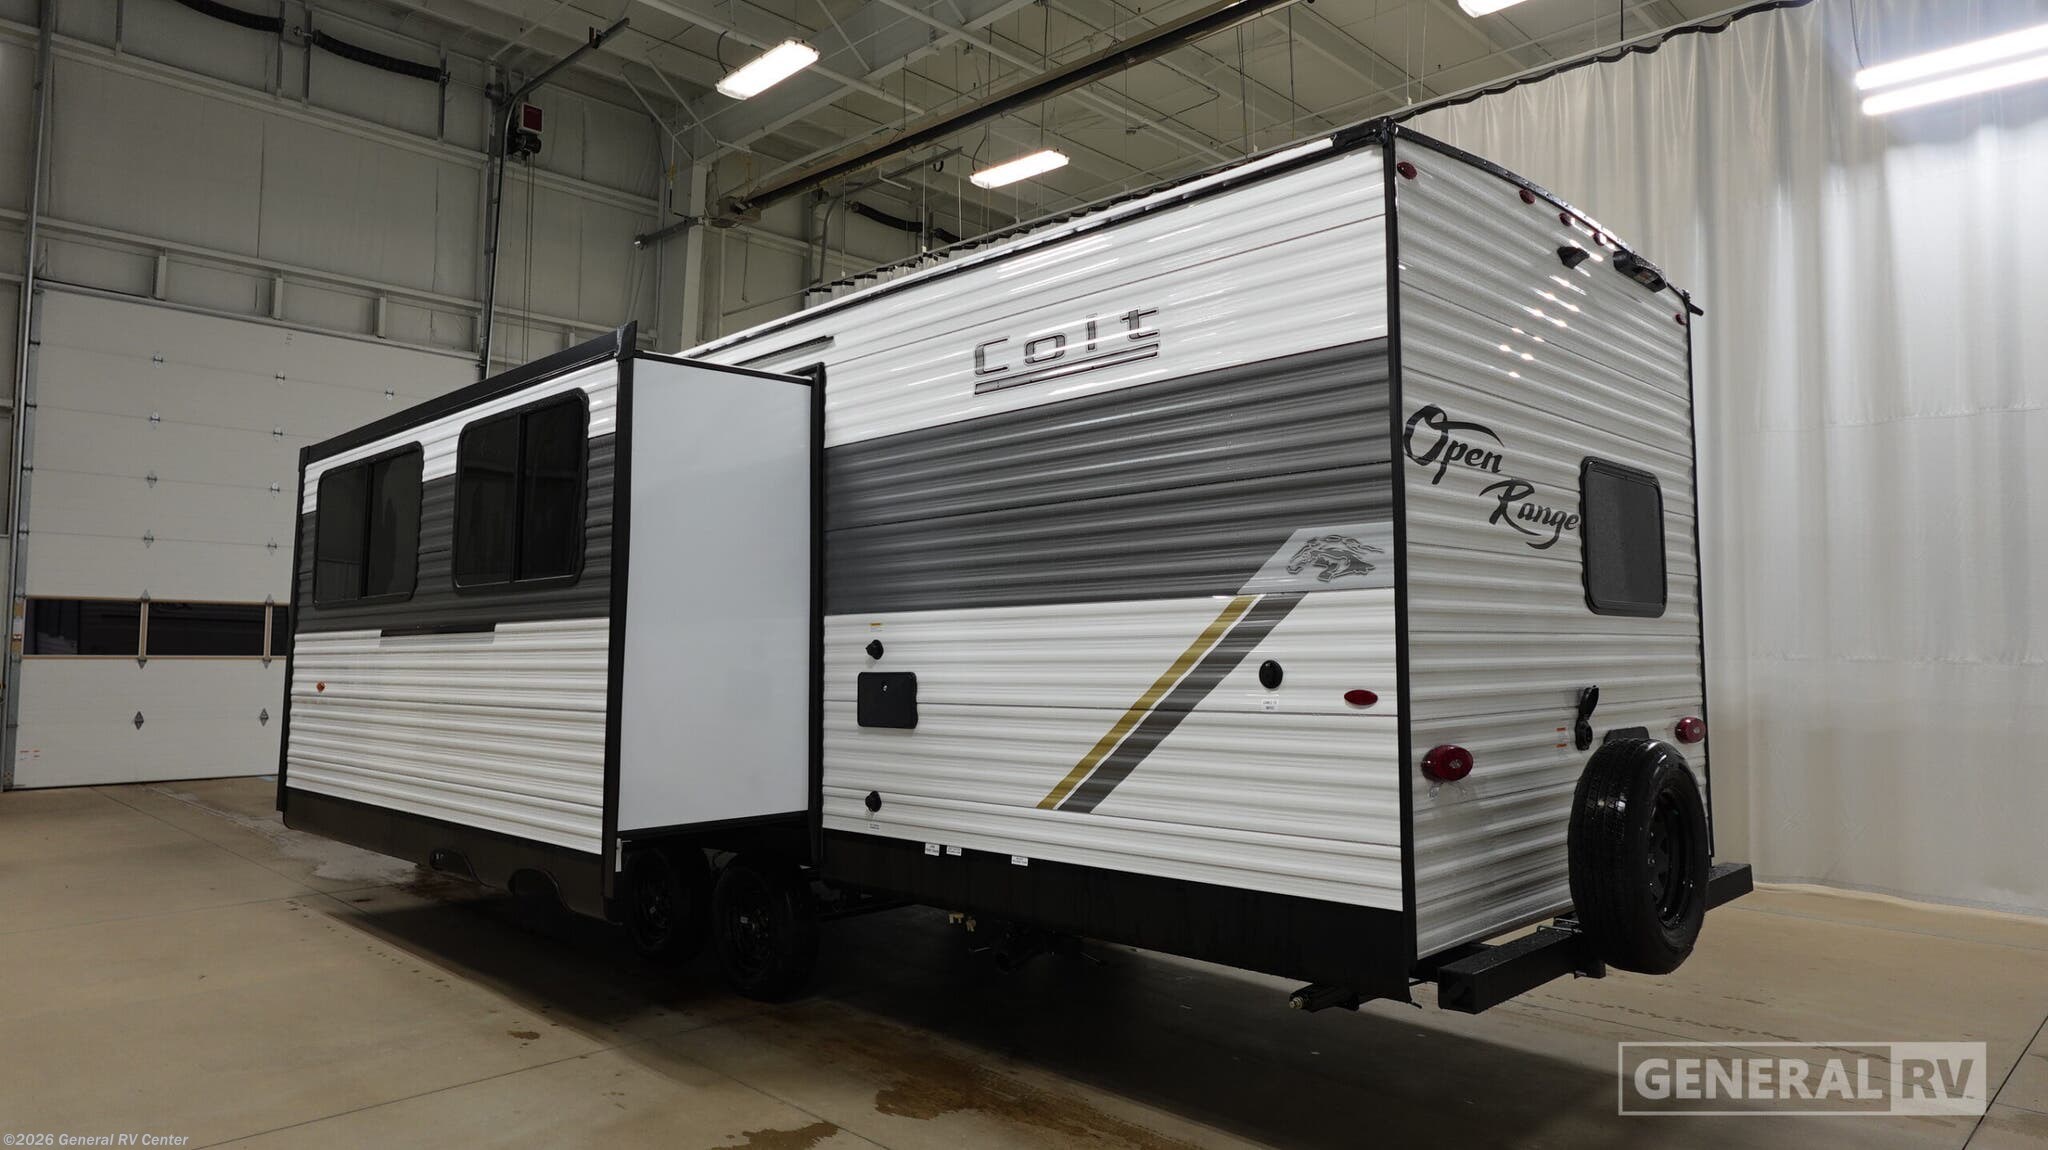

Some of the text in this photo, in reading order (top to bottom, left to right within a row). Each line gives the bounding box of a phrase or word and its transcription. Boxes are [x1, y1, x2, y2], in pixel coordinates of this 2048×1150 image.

[974, 306, 1160, 376] Colt
[1402, 403, 1505, 485] Open
[1478, 478, 1580, 550] Range
